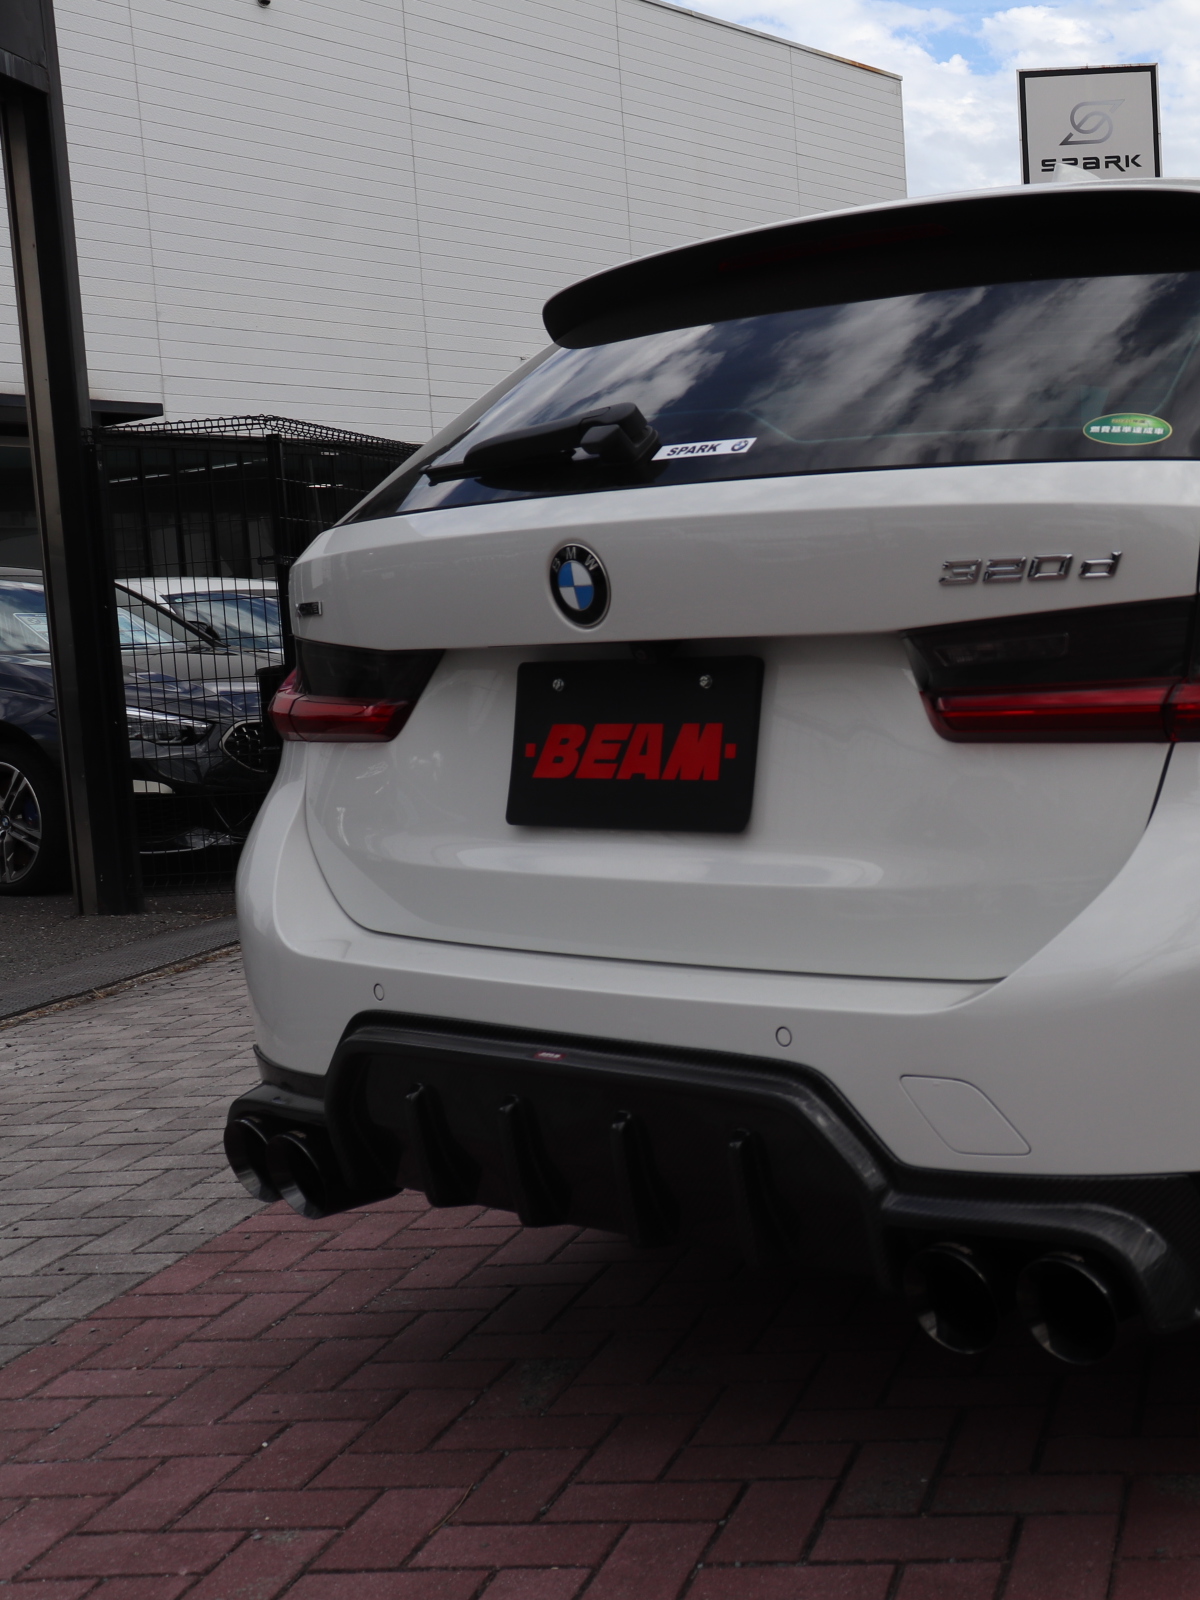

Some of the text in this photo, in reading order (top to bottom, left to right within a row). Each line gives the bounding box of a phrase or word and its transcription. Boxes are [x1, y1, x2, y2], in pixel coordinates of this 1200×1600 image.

[666, 442, 722, 457] SPARK
[551, 546, 599, 573] BMW
[531, 722, 724, 781] BEAM
